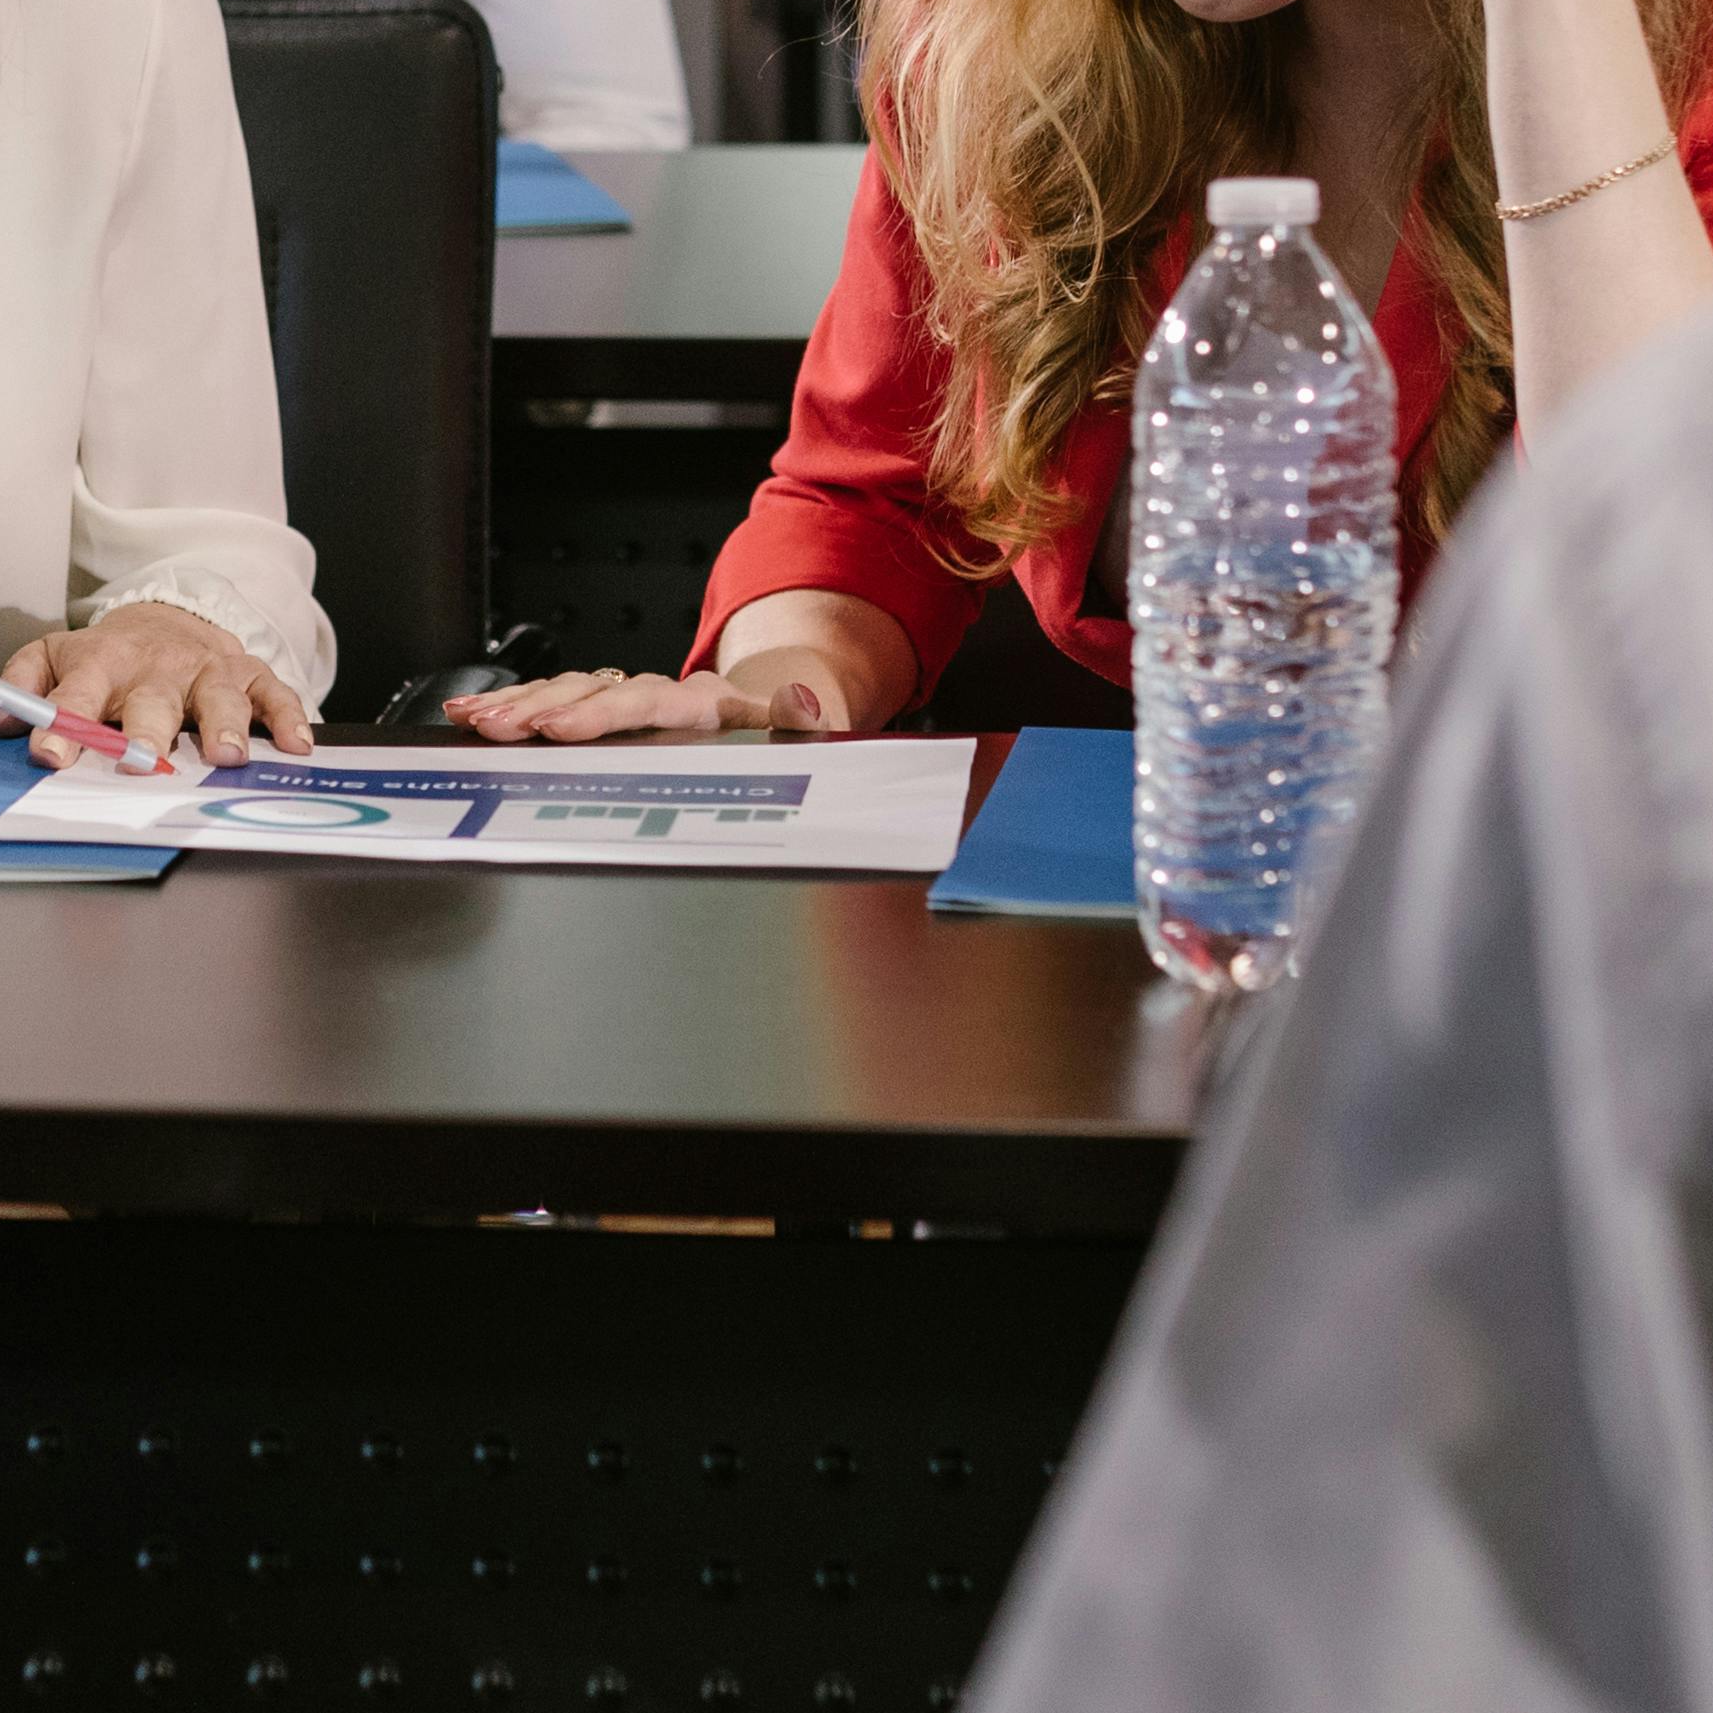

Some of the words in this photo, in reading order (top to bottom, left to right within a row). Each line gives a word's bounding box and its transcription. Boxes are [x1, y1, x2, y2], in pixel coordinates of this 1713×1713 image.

[258, 773, 366, 789] Skills
[382, 781, 530, 792] Graphs
[546, 783, 625, 793] and
[637, 786, 775, 798] Charts
